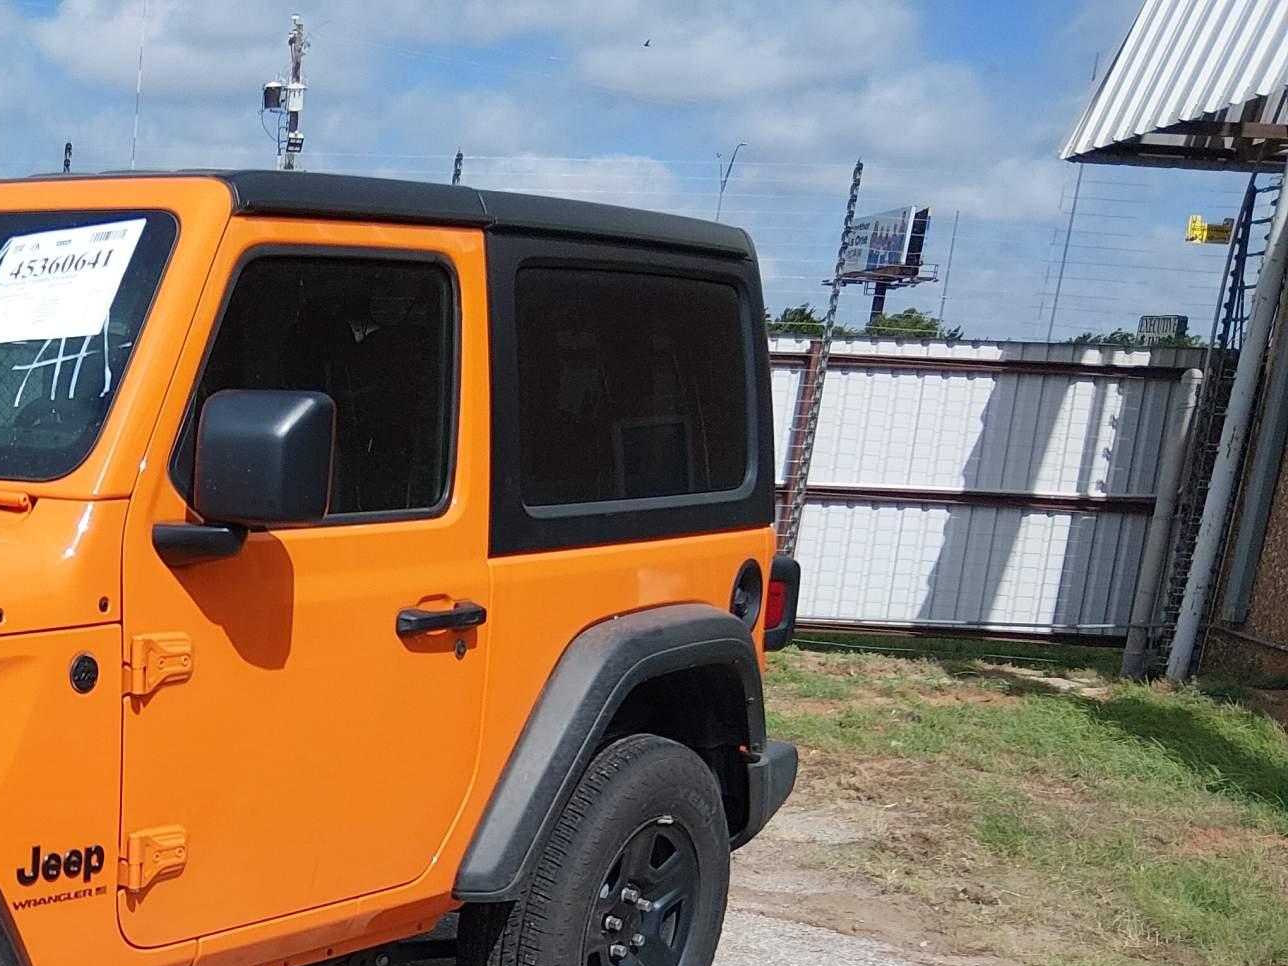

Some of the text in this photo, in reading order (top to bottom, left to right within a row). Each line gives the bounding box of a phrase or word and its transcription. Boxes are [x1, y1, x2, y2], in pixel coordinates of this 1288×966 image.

[10, 247, 115, 280] 45360641
[17, 845, 104, 886] Jeep
[12, 888, 93, 911] WRANGLER
